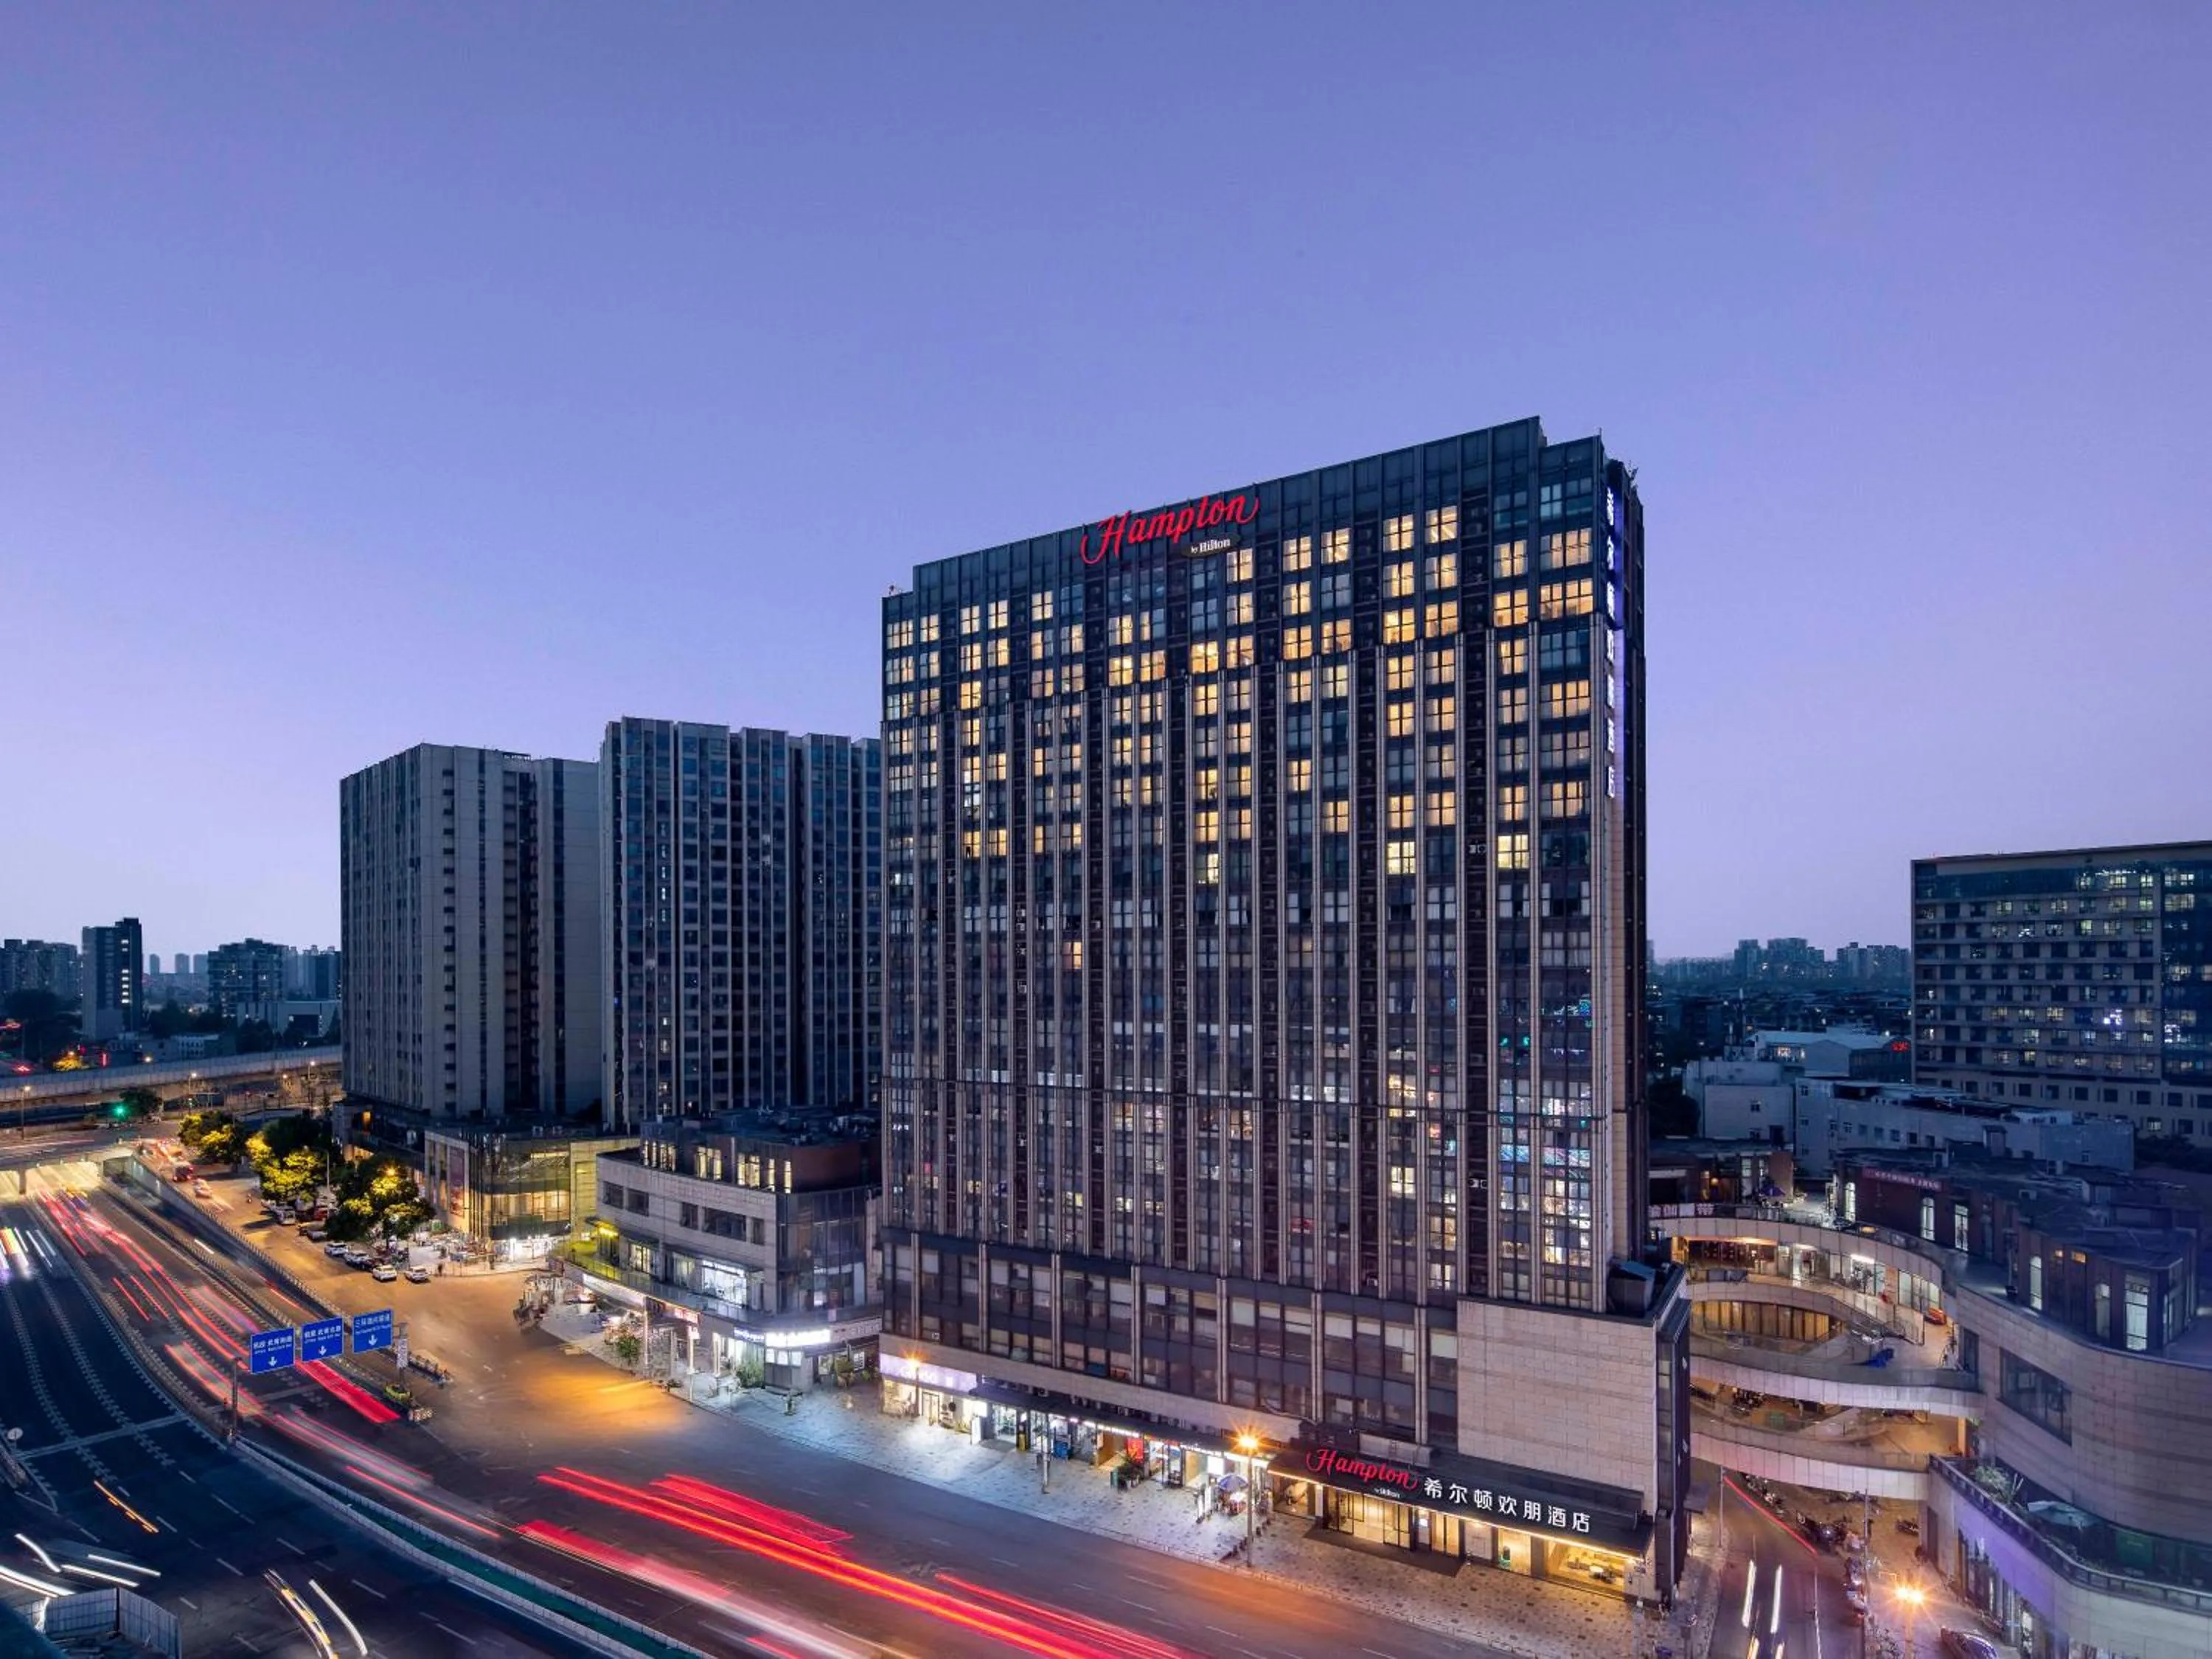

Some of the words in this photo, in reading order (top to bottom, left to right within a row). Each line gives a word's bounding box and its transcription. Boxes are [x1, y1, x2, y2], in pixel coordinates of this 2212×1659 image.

[1079, 495, 1260, 564] Hampton
[1200, 538, 1231, 553] Hilton
[1306, 1449, 1419, 1489] Hampton
[1424, 1477, 1590, 1533] 希尔顿欢朋酒店
